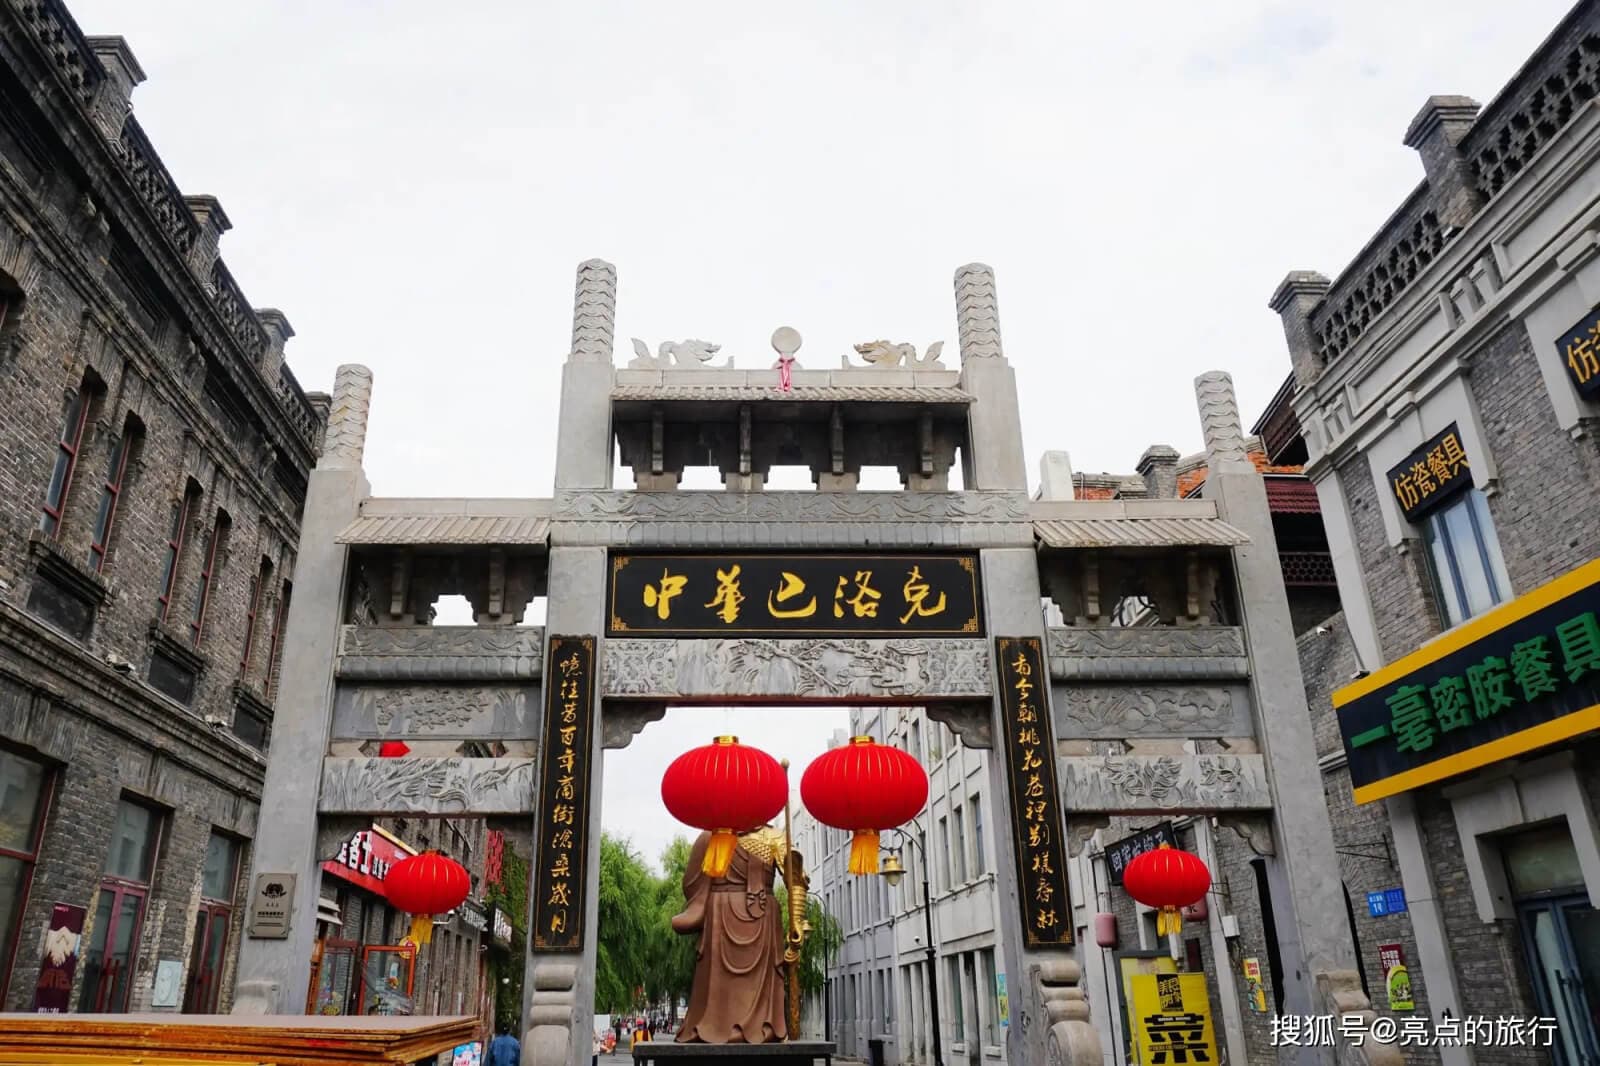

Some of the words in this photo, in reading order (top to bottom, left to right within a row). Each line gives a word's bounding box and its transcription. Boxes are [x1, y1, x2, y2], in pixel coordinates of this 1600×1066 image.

[1566, 319, 1600, 384] 仿
[1394, 433, 1469, 511] 仿瓷餐具
[1350, 611, 1600, 753] 一毫密胺餐具
